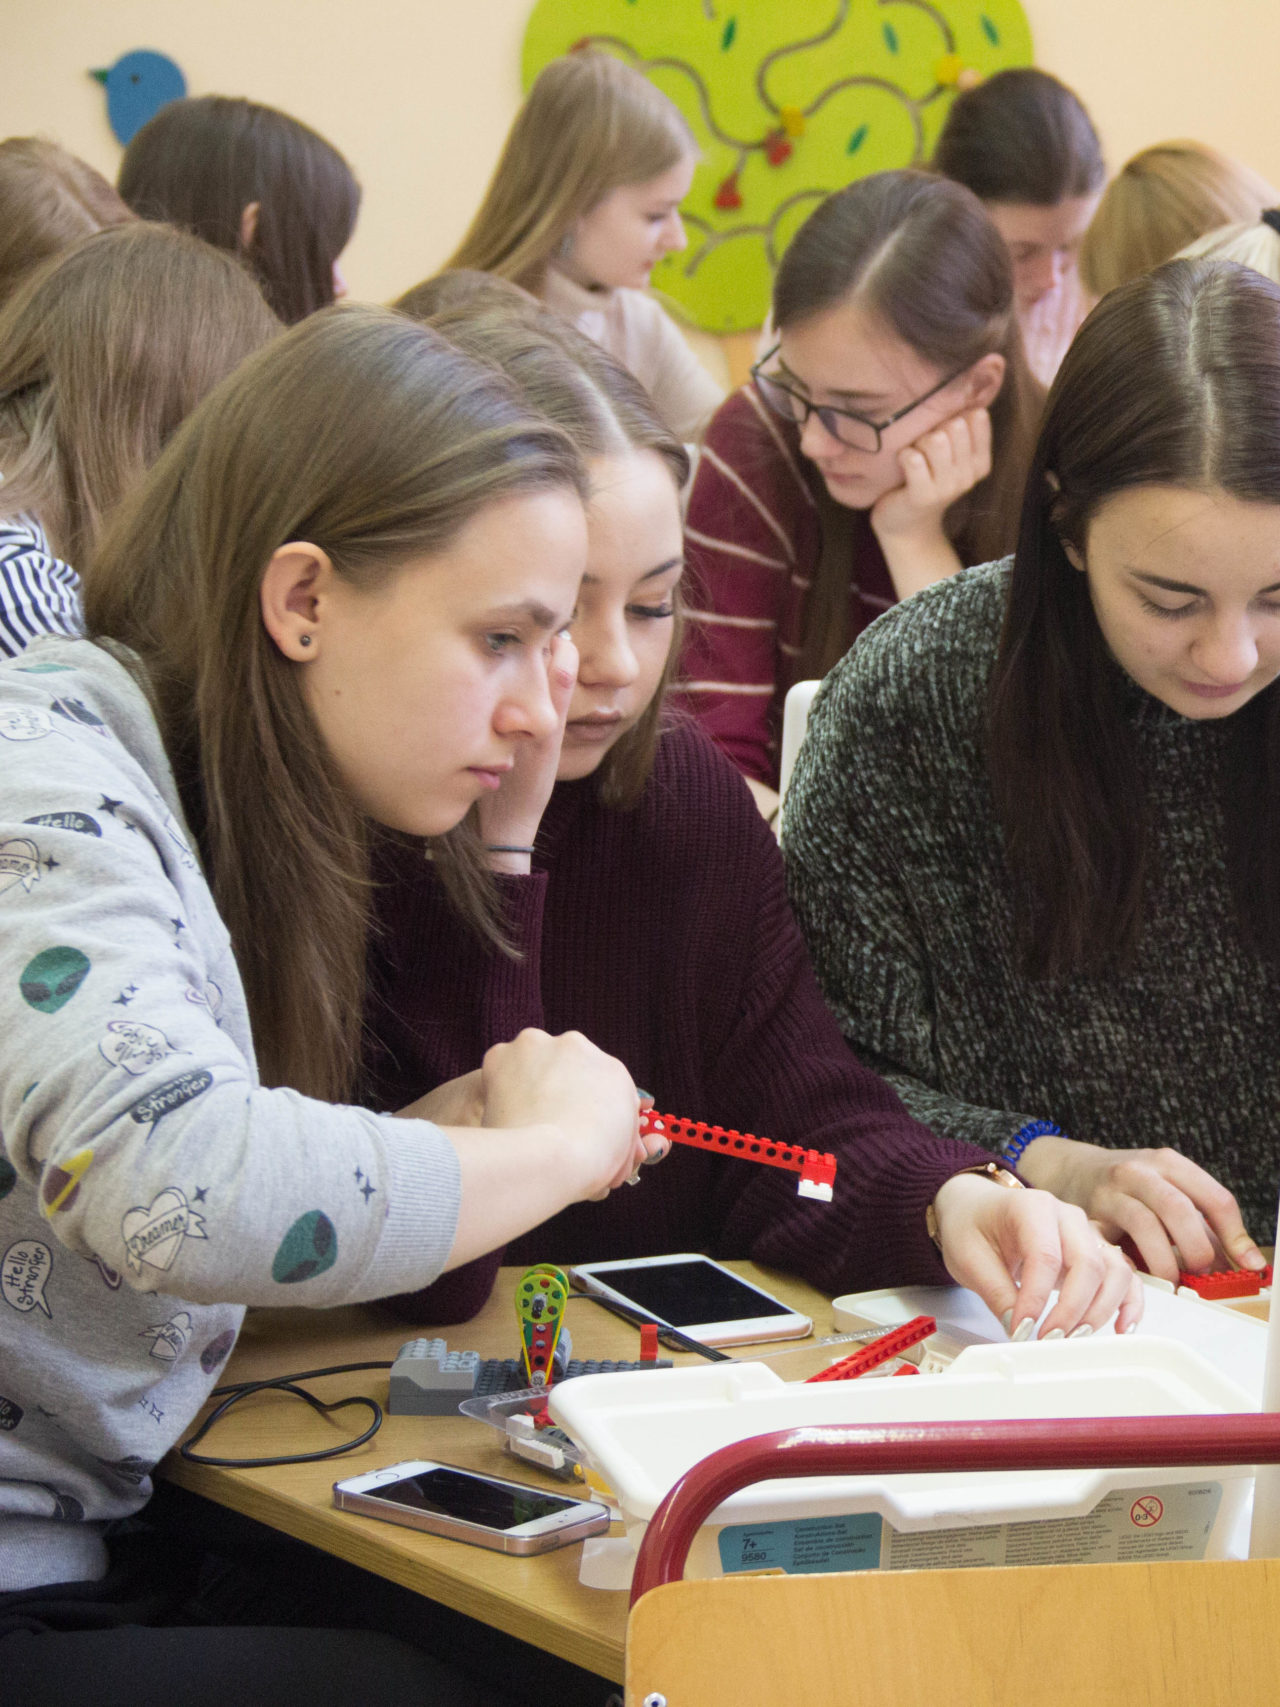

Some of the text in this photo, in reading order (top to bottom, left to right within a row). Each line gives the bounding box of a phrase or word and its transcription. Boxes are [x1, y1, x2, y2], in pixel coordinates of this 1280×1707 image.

[38, 814, 85, 829] Hello
[4, 1251, 28, 1287] Hello
[17, 1247, 47, 1305] Stranger
[742, 1538, 757, 1551] 7+
[741, 1552, 767, 1562] 9580
